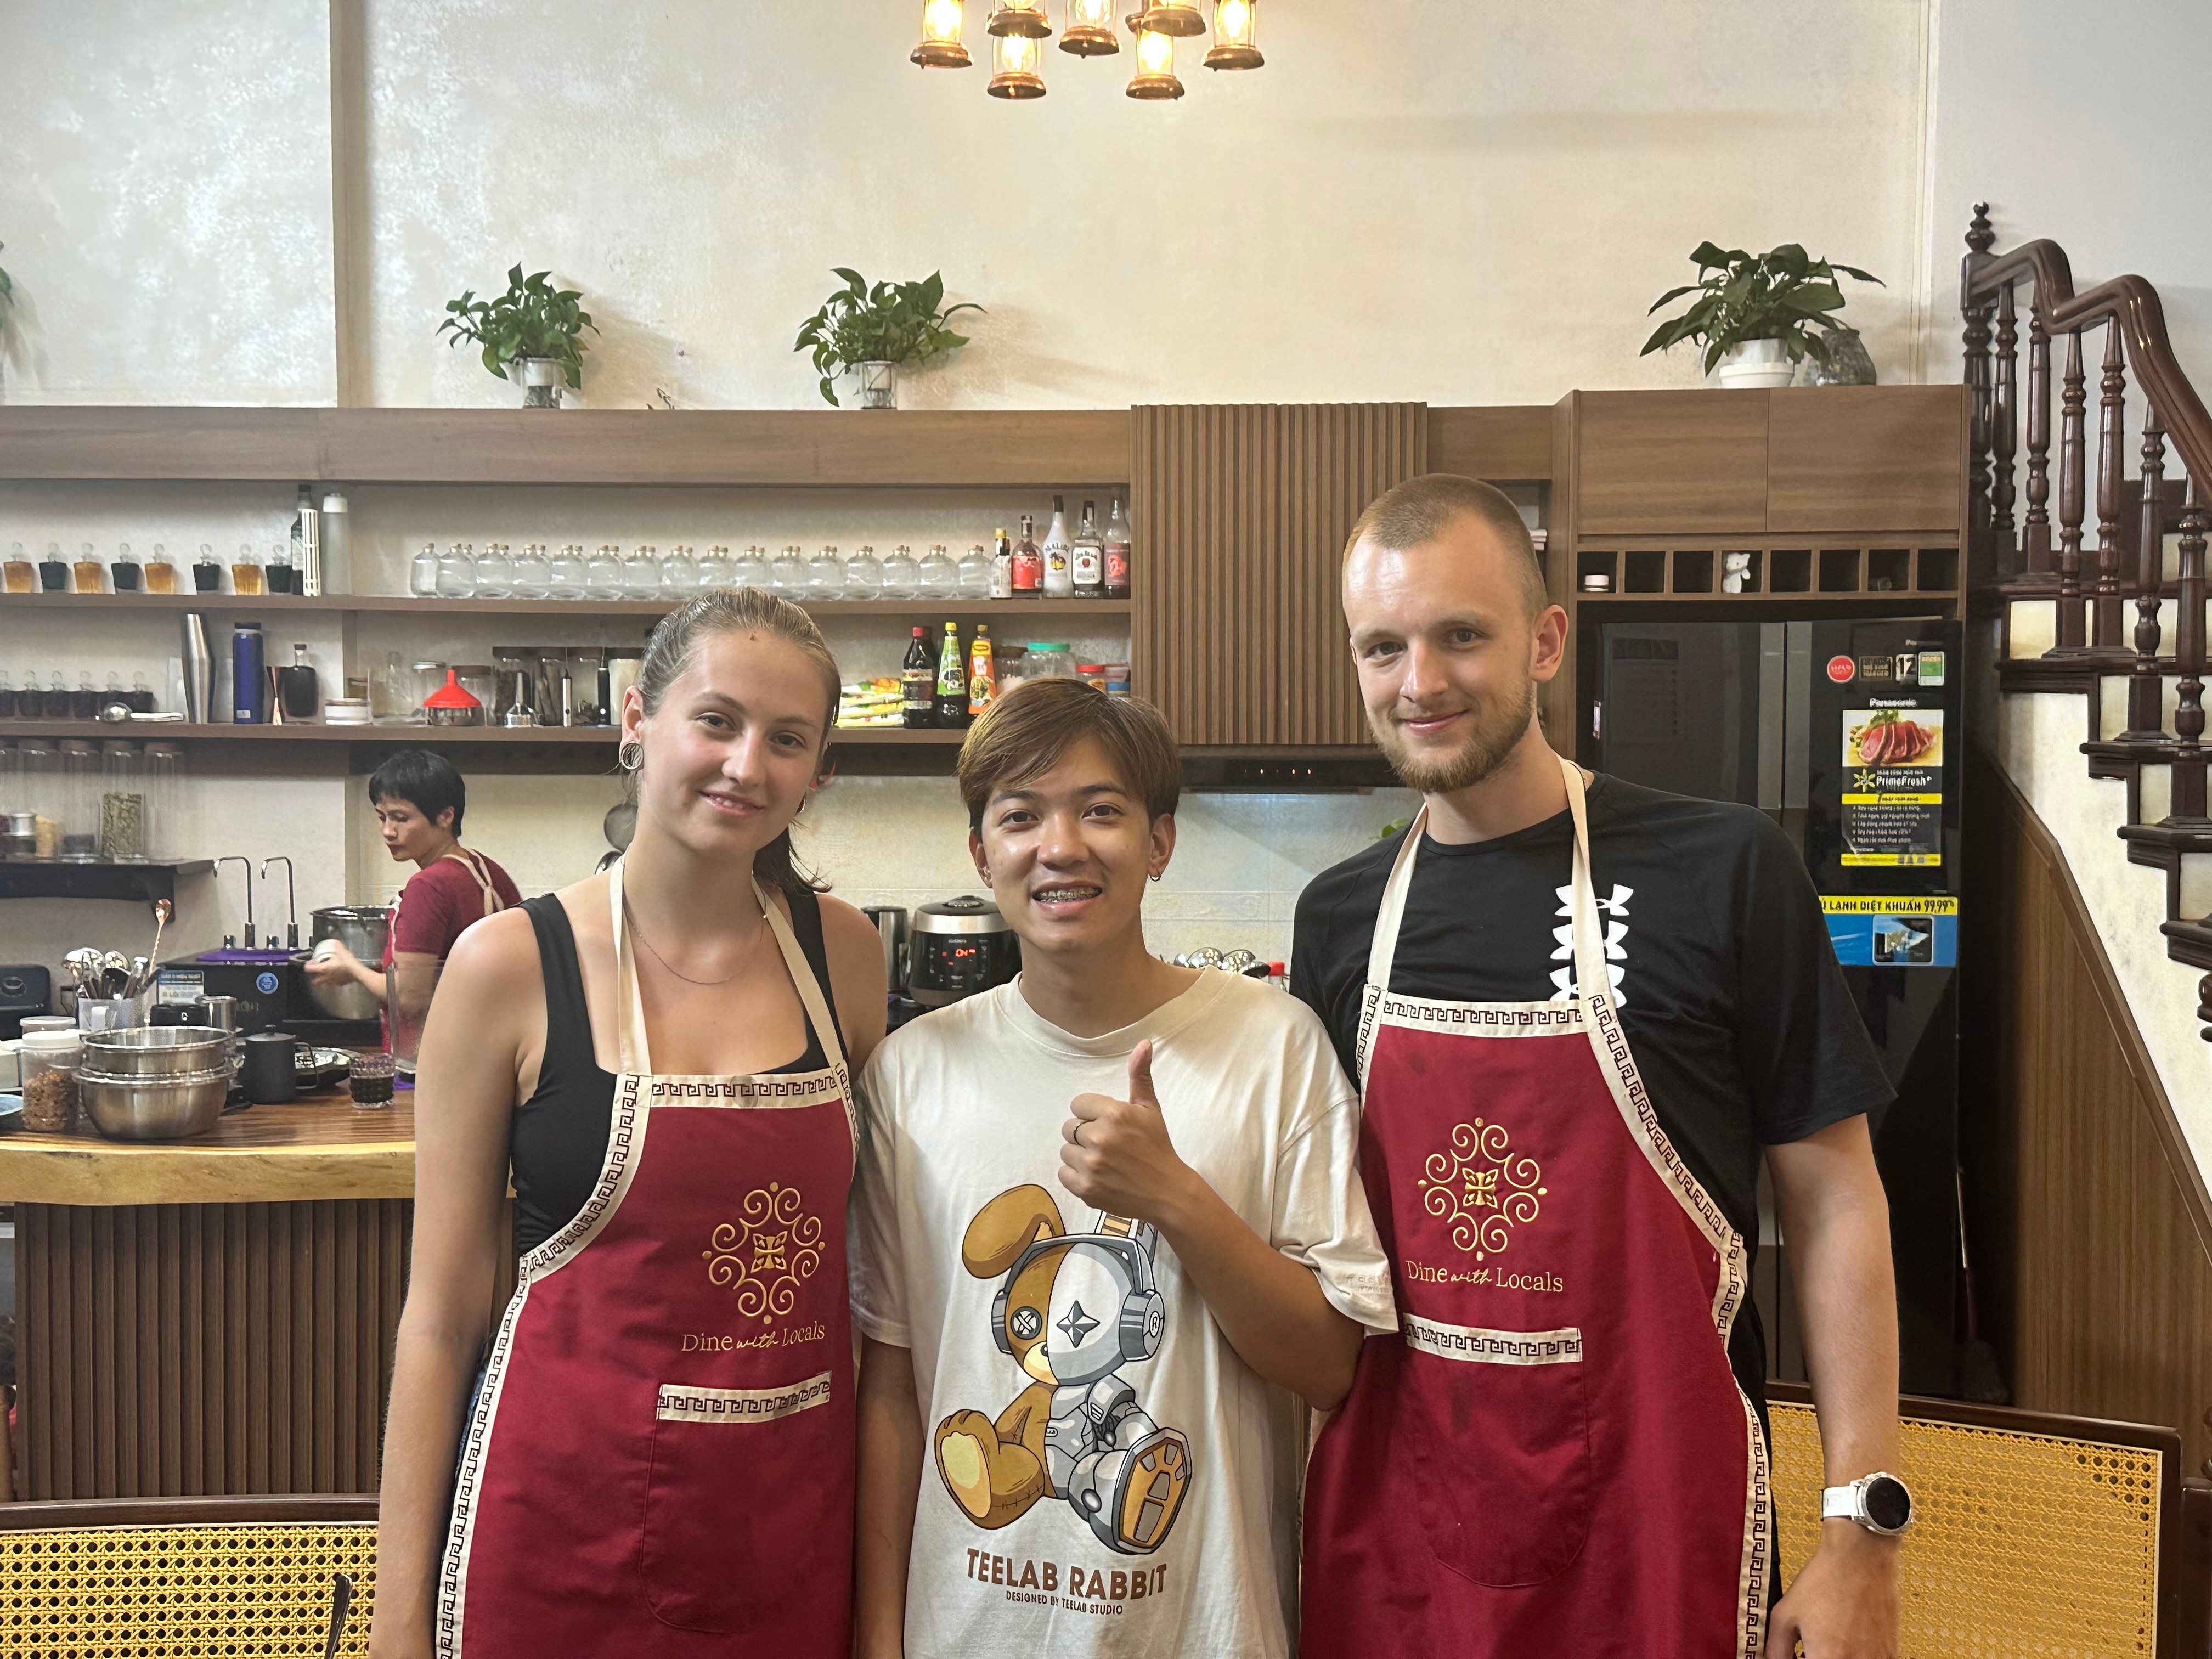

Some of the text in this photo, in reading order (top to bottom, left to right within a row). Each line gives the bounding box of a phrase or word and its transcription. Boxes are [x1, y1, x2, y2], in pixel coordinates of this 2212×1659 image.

[1870, 698, 1917, 707] Panasonic
[1405, 1260, 1563, 1293] Dine with Locals
[681, 1321, 825, 1351] Dine with Locals
[967, 1548, 1167, 1601] TEELAB RABBIT
[1006, 1590, 1124, 1615] DESIGNED BY TEELAB STUDIO
